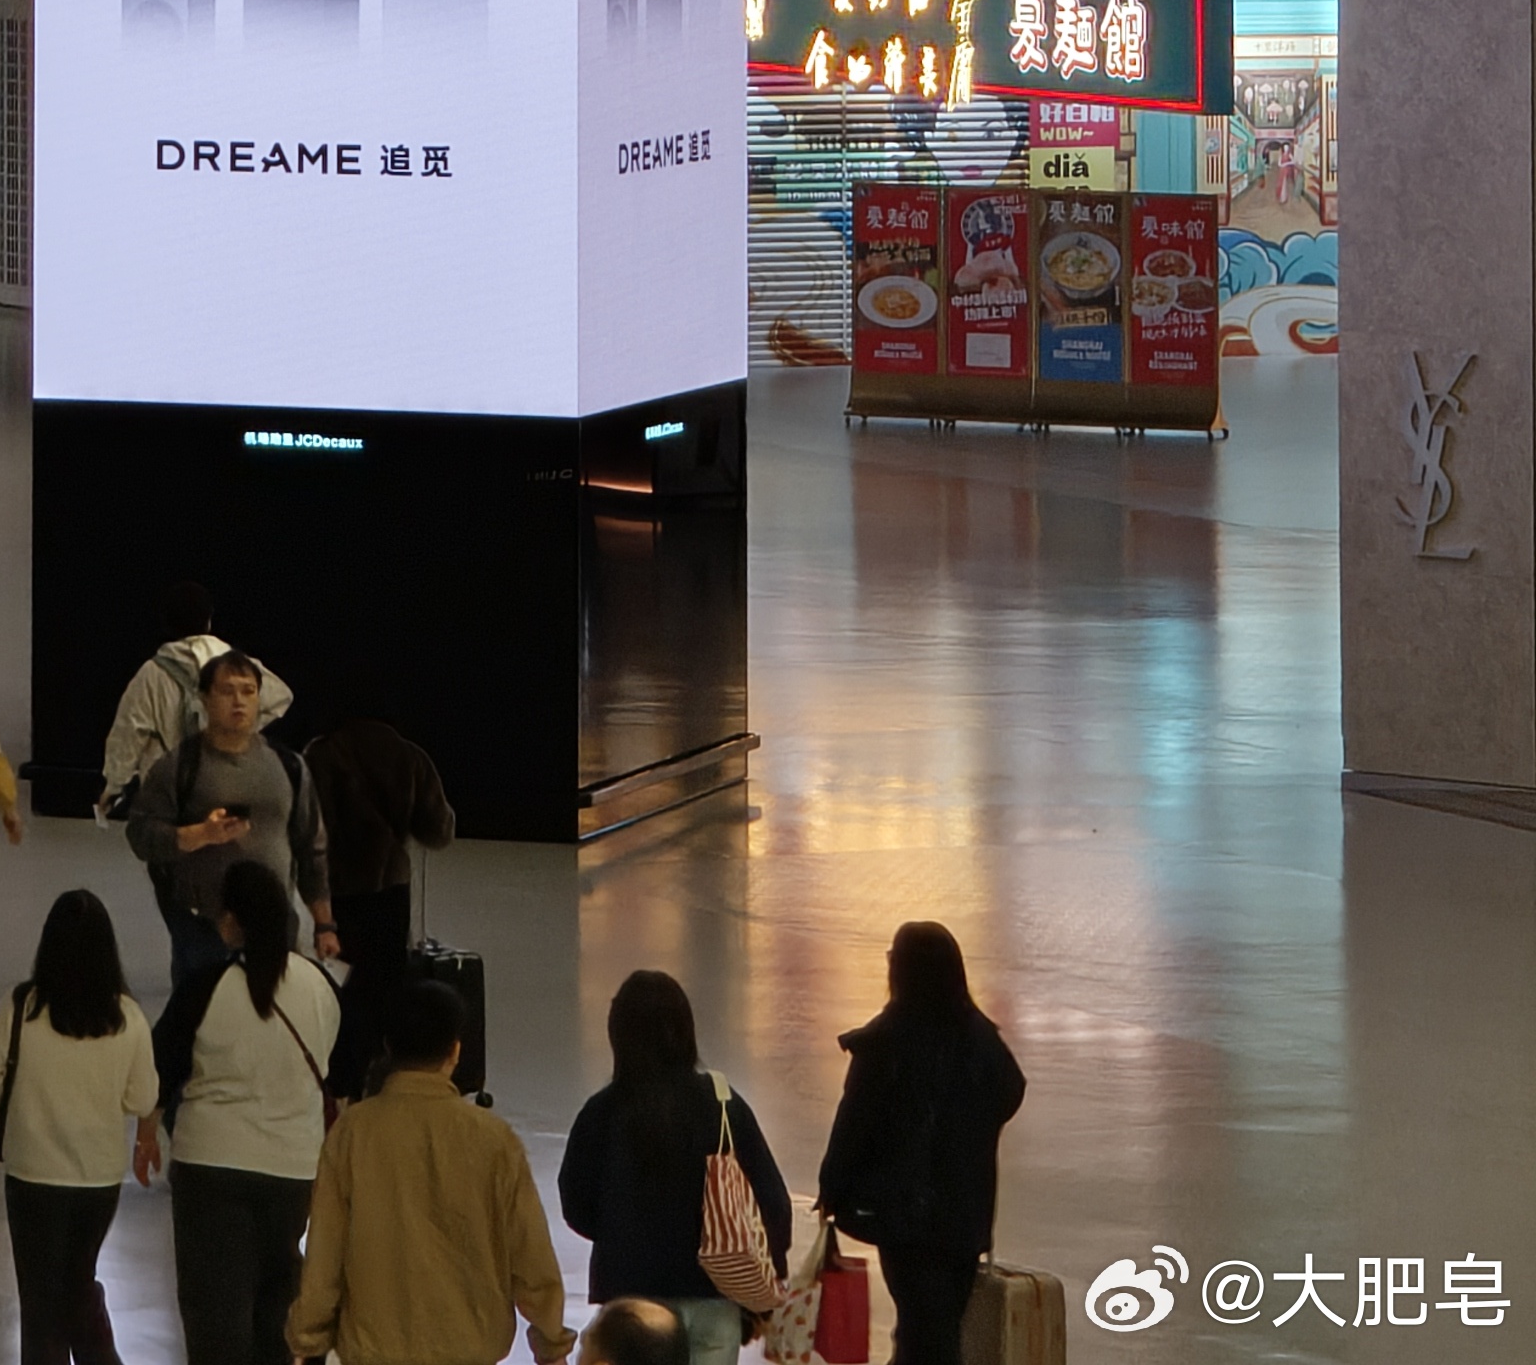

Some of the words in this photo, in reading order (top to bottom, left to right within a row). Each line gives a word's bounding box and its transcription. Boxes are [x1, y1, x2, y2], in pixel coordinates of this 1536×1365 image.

[157, 139, 362, 174] DREAME
[380, 145, 452, 177] 追觅
[619, 135, 685, 174] DREAME
[688, 129, 712, 162] 追觅
[295, 434, 363, 449] JCDecaux
